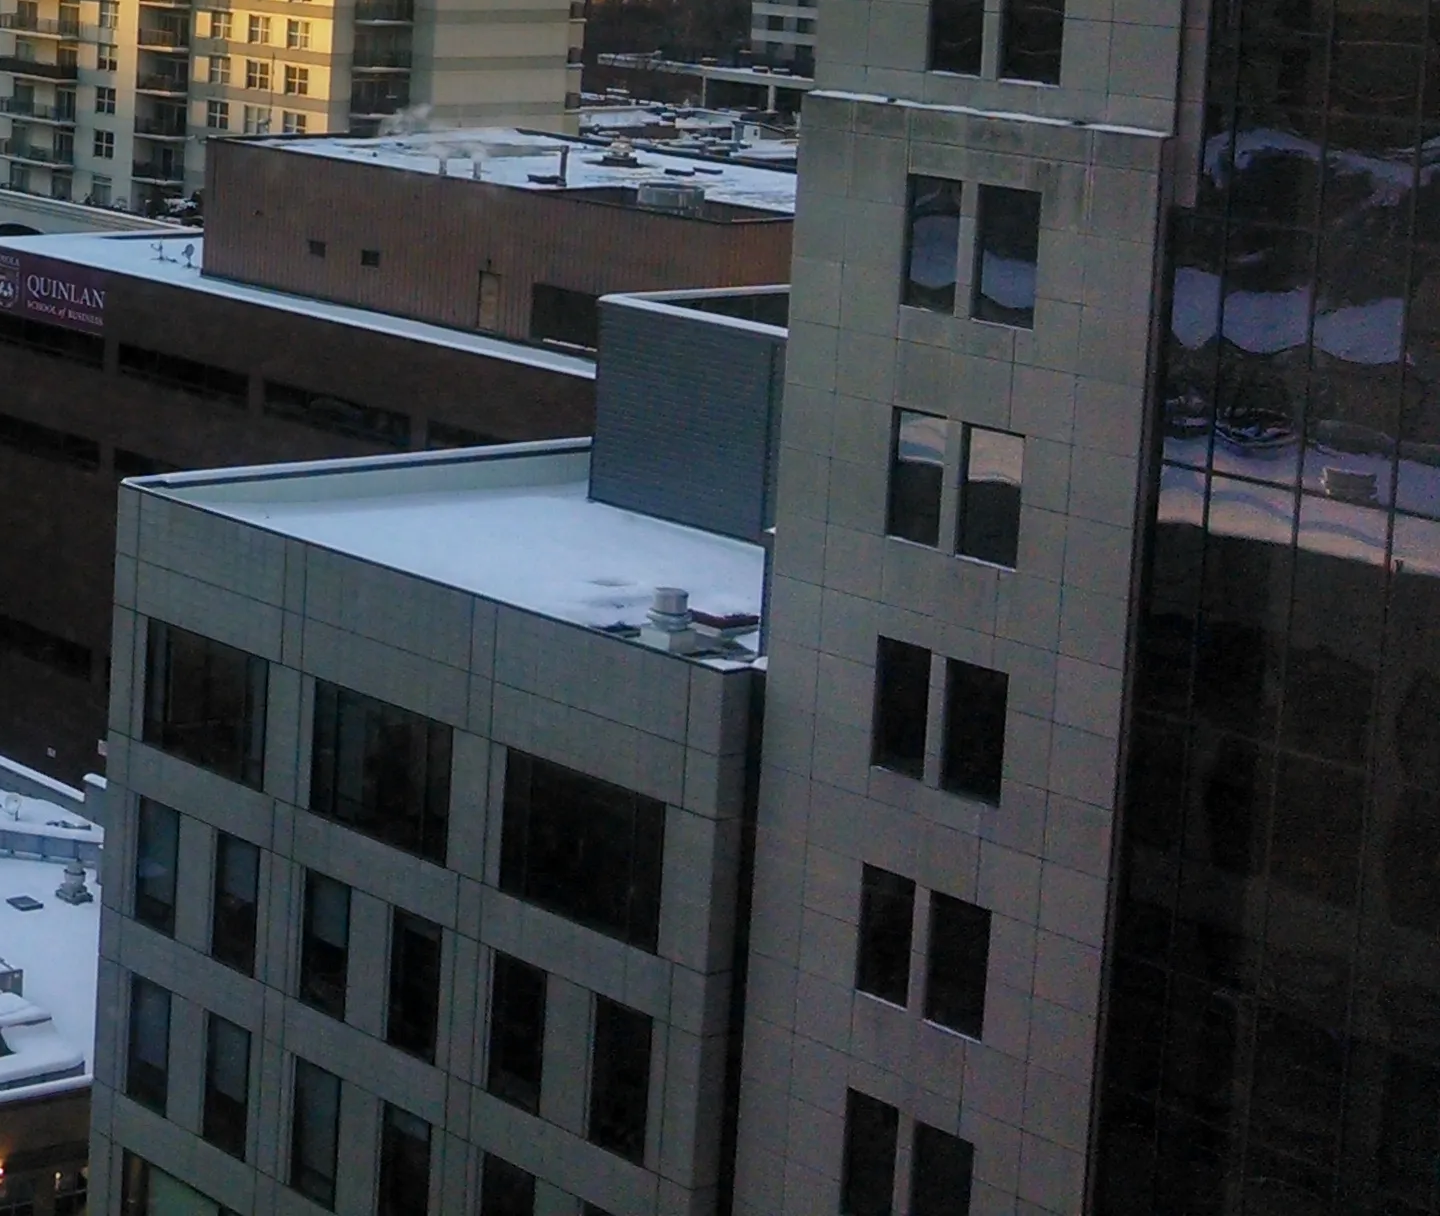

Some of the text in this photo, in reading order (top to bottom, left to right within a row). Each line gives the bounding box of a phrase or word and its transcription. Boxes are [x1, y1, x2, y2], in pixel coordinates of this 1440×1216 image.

[26, 273, 106, 309] QUINLAN
[26, 299, 57, 315] SCHOOL
[68, 308, 104, 326] BUSINESS
